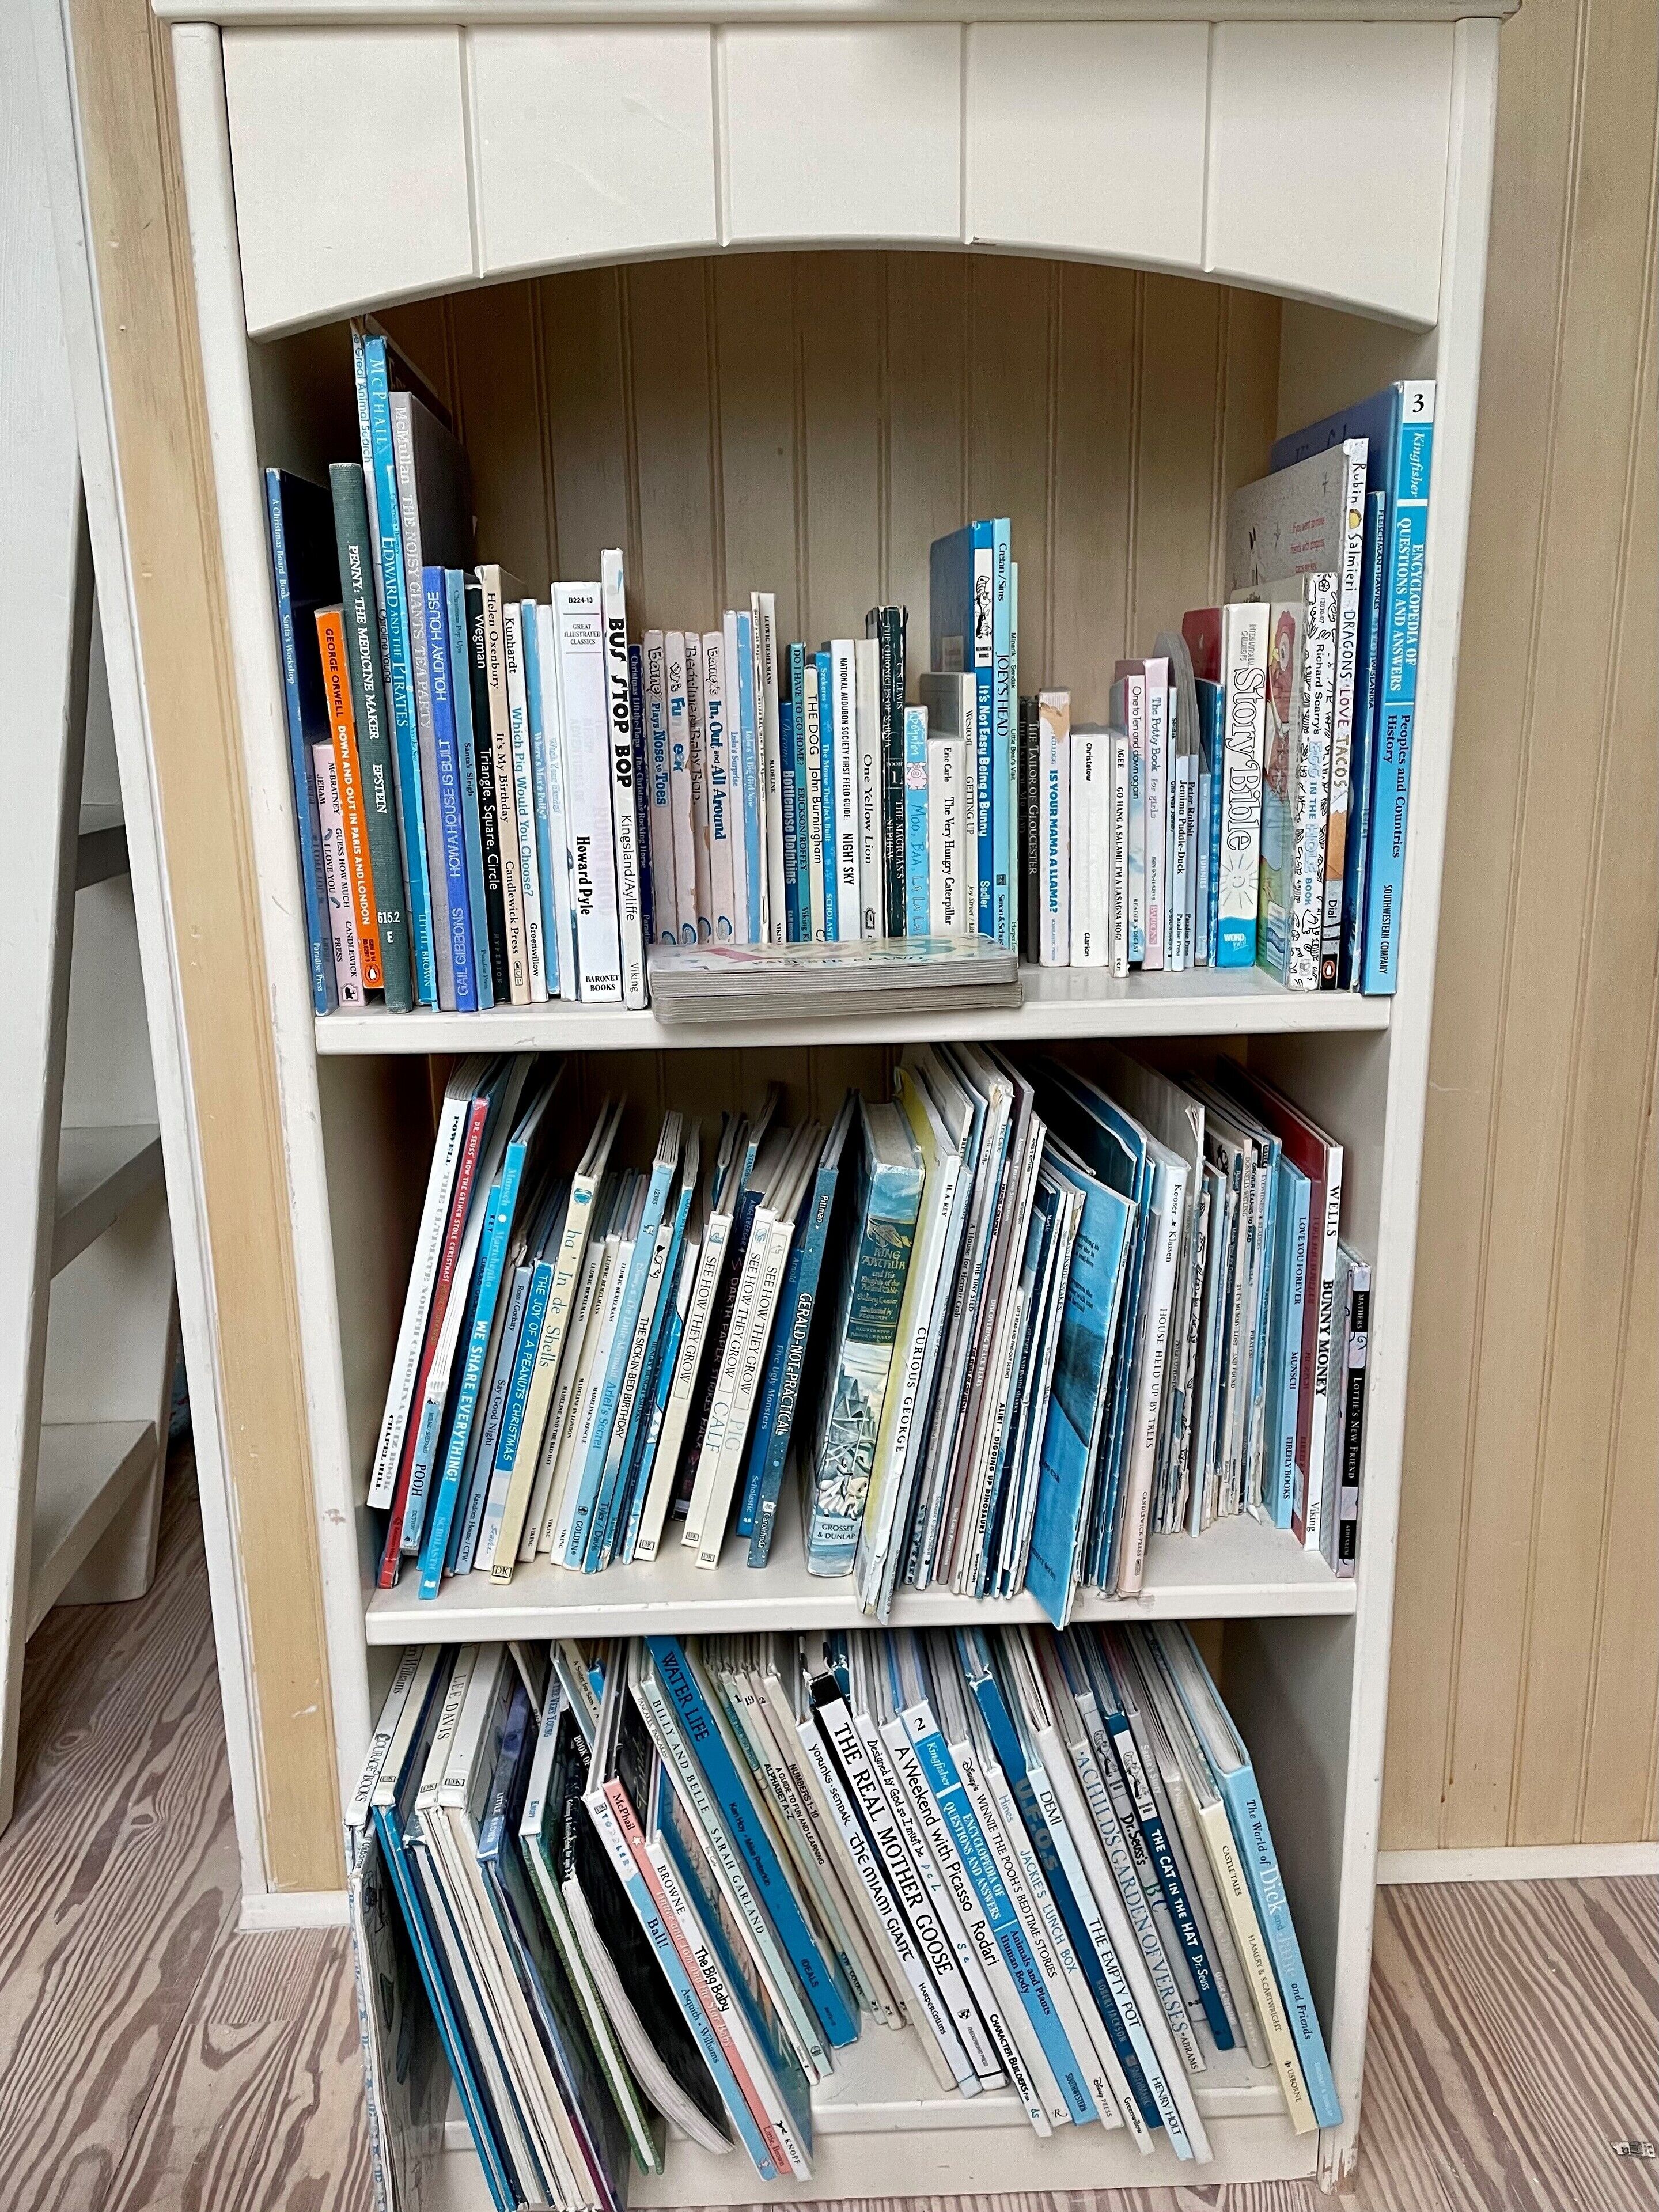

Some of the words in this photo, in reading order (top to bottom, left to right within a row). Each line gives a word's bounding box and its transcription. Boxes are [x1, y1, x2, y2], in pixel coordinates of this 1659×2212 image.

[1412, 394, 1425, 413] 3
[1405, 431, 1427, 498] Kingfisher
[1349, 463, 1368, 504] Rubin
[347, 544, 363, 593] PENNY:
[1343, 533, 1362, 592] Salmieri
[354, 596, 366, 623] THE
[486, 592, 498, 627] Helen
[325, 628, 338, 672] GEORGE
[471, 613, 487, 668] Wegman
[504, 617, 519, 673] Kunhardt
[608, 618, 626, 662] BUS
[1338, 610, 1357, 679] DRAGONS
[357, 627, 373, 691] MEDICINE
[487, 630, 501, 689] Oxenbury
[331, 674, 344, 717] ORWELL
[611, 675, 630, 734] STOP
[979, 685, 990, 702] It's
[1224, 666, 1267, 755] Story
[1336, 688, 1351, 729] LOVE
[365, 694, 379, 739] MAKER
[511, 707, 525, 748] Which
[979, 705, 989, 725] Not
[338, 725, 349, 758] DOWN
[976, 728, 989, 754] Easy
[1382, 715, 1397, 763] History
[1396, 714, 1411, 764] Peoples
[342, 760, 352, 784] AND
[478, 748, 494, 801] Triangle,
[495, 753, 507, 771] My
[513, 752, 527, 772] Pig
[616, 744, 632, 787] BOP
[863, 754, 873, 782] One
[976, 757, 989, 789] Being
[1333, 736, 1350, 787] TACOS
[372, 763, 387, 814] EPSTEIN
[516, 777, 529, 816] Would
[1396, 768, 1407, 792] and
[345, 787, 355, 809] OUT
[497, 775, 512, 823] Birthday
[863, 787, 873, 831] Yellow
[944, 797, 953, 815] The
[1225, 759, 1264, 852] Bible
[349, 812, 357, 825] IN
[482, 804, 497, 850] Square,
[518, 819, 531, 842] You
[942, 817, 953, 837] Very
[977, 801, 988, 836] Bunny
[1391, 796, 1405, 858] Countries
[350, 827, 361, 854] PARIS
[842, 833, 853, 863] NIGHT
[864, 835, 873, 864] Lion
[941, 840, 953, 874] Hungry
[354, 856, 363, 878] AND
[487, 853, 500, 890] Circle
[520, 845, 535, 896] Choose?
[575, 836, 591, 885] Howard
[619, 815, 639, 921] Kingsland/Ayliffe
[843, 867, 854, 885] SKY
[357, 880, 370, 925] LONDON
[578, 888, 593, 915] Pyle
[942, 877, 954, 925] Caterpillar
[979, 881, 989, 907] Sadler
[1327, 899, 1338, 918] Dial
[528, 922, 541, 976] Greenwillow
[628, 963, 640, 993] Viking
[815, 1195, 829, 1223] Pittman
[1171, 1184, 1182, 1214] Kooser
[1326, 1185, 1340, 1237] WELLS
[1298, 1217, 1306, 1239] LOVE
[747, 1252, 761, 1273] SEE
[1164, 1230, 1177, 1263] Klassen
[1297, 1241, 1305, 1262] YOU
[740, 1275, 756, 1306] HOW
[1294, 1263, 1304, 1304] FOREVER
[733, 1307, 749, 1336] THEY
[1319, 1279, 1335, 1335] BUNNY
[1355, 1294, 1365, 1329] MATHERS
[637, 1316, 649, 1336] THE
[1156, 1309, 1167, 1344] HOUSE
[624, 1337, 645, 1392] SICK-IN-BED
[724, 1338, 742, 1378] GROW
[906, 1326, 927, 1388] CURIOUS
[1153, 1350, 1162, 1378] HELD
[1289, 1351, 1298, 1390] MUNSCH
[1315, 1339, 1331, 1396] MONEY
[494, 1378, 505, 1394] Say
[1150, 1383, 1159, 1396] UP
[490, 1396, 502, 1420] Good
[613, 1392, 632, 1438] BIRTHDAY
[894, 1396, 913, 1453] GEORGE
[1149, 1401, 1157, 1413] BY
[482, 1422, 497, 1447] Night
[704, 1400, 730, 1453] CALF
[1145, 1417, 1155, 1448] TREES
[1285, 1436, 1294, 1468] FIREFLY
[411, 1463, 426, 1497] POOH
[1282, 1470, 1291, 1499] BOOKS
[755, 1512, 772, 1549] Carolrhoda
[1306, 1501, 1320, 1532] Viking
[659, 1650, 695, 1709] WATER
[684, 1707, 709, 1743] LIFE
[914, 1718, 926, 1731] 2
[894, 1744, 912, 1760] A
[924, 1741, 951, 1788] Kingfisher
[612, 1792, 635, 1830] McPhail
[901, 1760, 941, 1827] Weekend
[1039, 1790, 1062, 1826] DEMI
[1245, 1799, 1259, 1819] The
[833, 1722, 863, 1765] THE
[853, 1768, 888, 1822] REAL
[877, 1825, 925, 1909] MOTHER
[914, 1912, 953, 1976] GOOSE
[930, 1826, 956, 1862] with
[1149, 1828, 1166, 1853] THE
[1251, 1821, 1268, 1852] World
[1158, 1855, 1175, 1879] CAT
[1222, 1845, 1235, 1872] CASTLE
[1229, 1873, 1242, 1896] TALES
[1258, 1854, 1270, 1866] of
[656, 1864, 686, 1916] BROWNE
[944, 1861, 978, 1913] Picasso
[1168, 1882, 1180, 1895] IN
[1259, 1867, 1288, 1915] Dick
[1173, 1897, 1188, 1919] THE
[646, 1916, 669, 1949] Ball!
[968, 1919, 1002, 1967] Rodari
[1181, 1921, 1198, 1947] HAT
[693, 1945, 711, 1968] The
[999, 1934, 1021, 1971] Human
[1012, 1969, 1032, 1996] Body
[1010, 1928, 1032, 1967] Animals
[1026, 1967, 1040, 1986] and
[1034, 1986, 1052, 2016] Plants
[1086, 1917, 1109, 1948] THE
[1100, 1950, 1129, 1998] EMPTY
[1120, 2001, 1141, 2029] POT
[1192, 1954, 1205, 1969] Dr.
[700, 1965, 719, 1985] Big
[1196, 1968, 1211, 1991] Seuss
[1290, 1982, 1304, 2001] and
[710, 1982, 732, 2012] Baby
[1296, 2003, 1314, 2040] Friends
[1152, 2075, 1171, 2109] HENRY
[1165, 2109, 1182, 2137] HOLT
